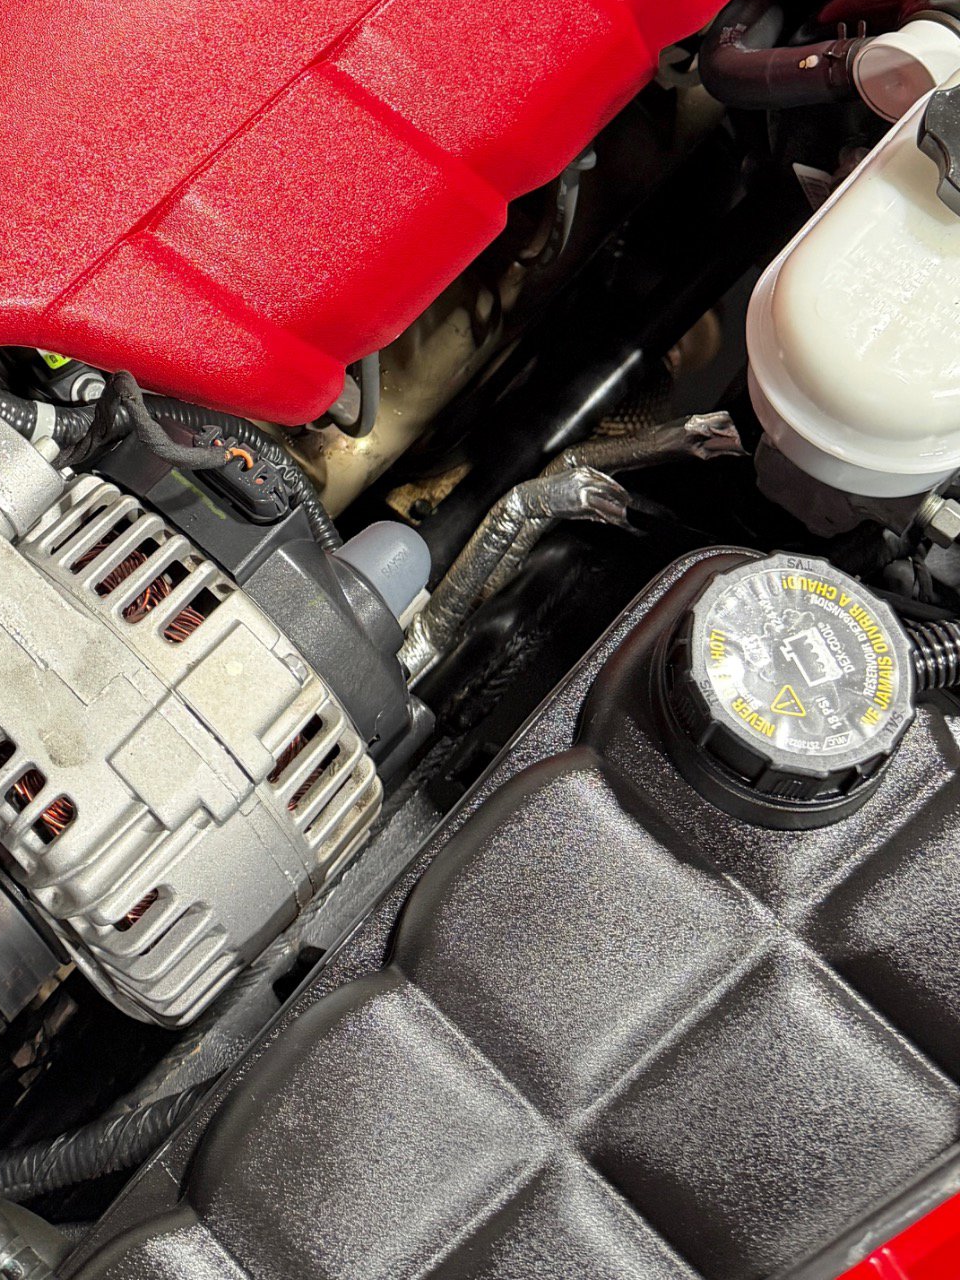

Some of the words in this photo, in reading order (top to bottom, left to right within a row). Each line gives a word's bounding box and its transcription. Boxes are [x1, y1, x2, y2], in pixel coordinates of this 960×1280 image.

[787, 558, 813, 571] TVS
[782, 576, 838, 600] CHAUD!
[848, 608, 889, 654] OUVRIR
[874, 656, 894, 710] JAMAIS
[731, 696, 776, 738] NEVER
[815, 696, 835, 716] PSI
[859, 706, 882, 728] NE
[826, 714, 842, 730] 18
